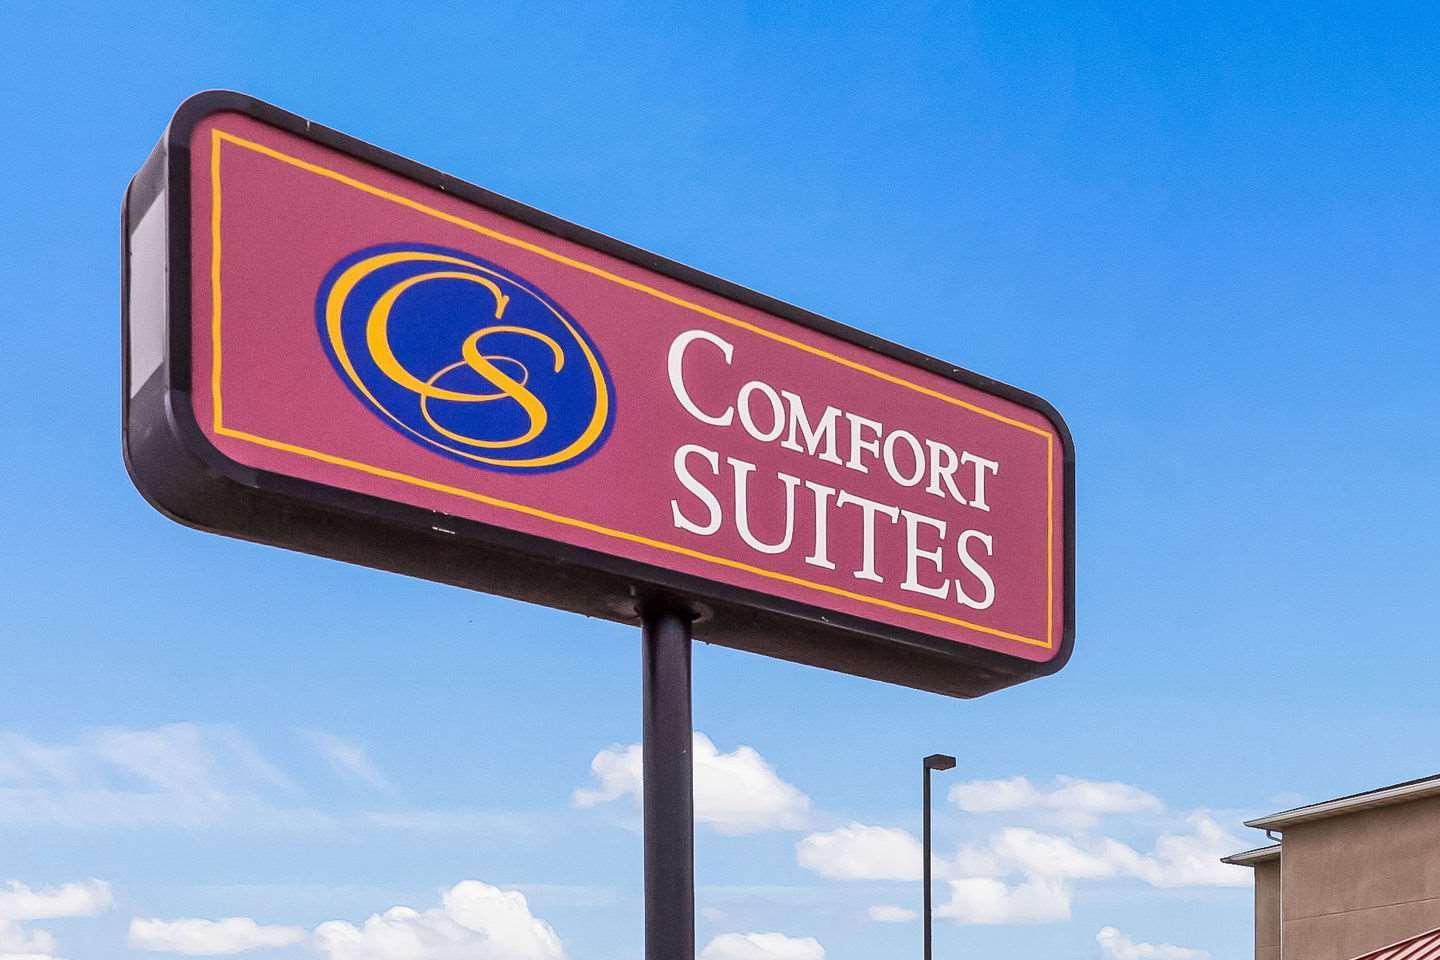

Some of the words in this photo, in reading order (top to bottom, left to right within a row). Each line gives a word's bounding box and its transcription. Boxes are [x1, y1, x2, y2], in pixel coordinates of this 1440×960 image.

[365, 271, 565, 449] CS
[667, 329, 999, 512] COMFORT
[671, 443, 996, 610] SUITES
